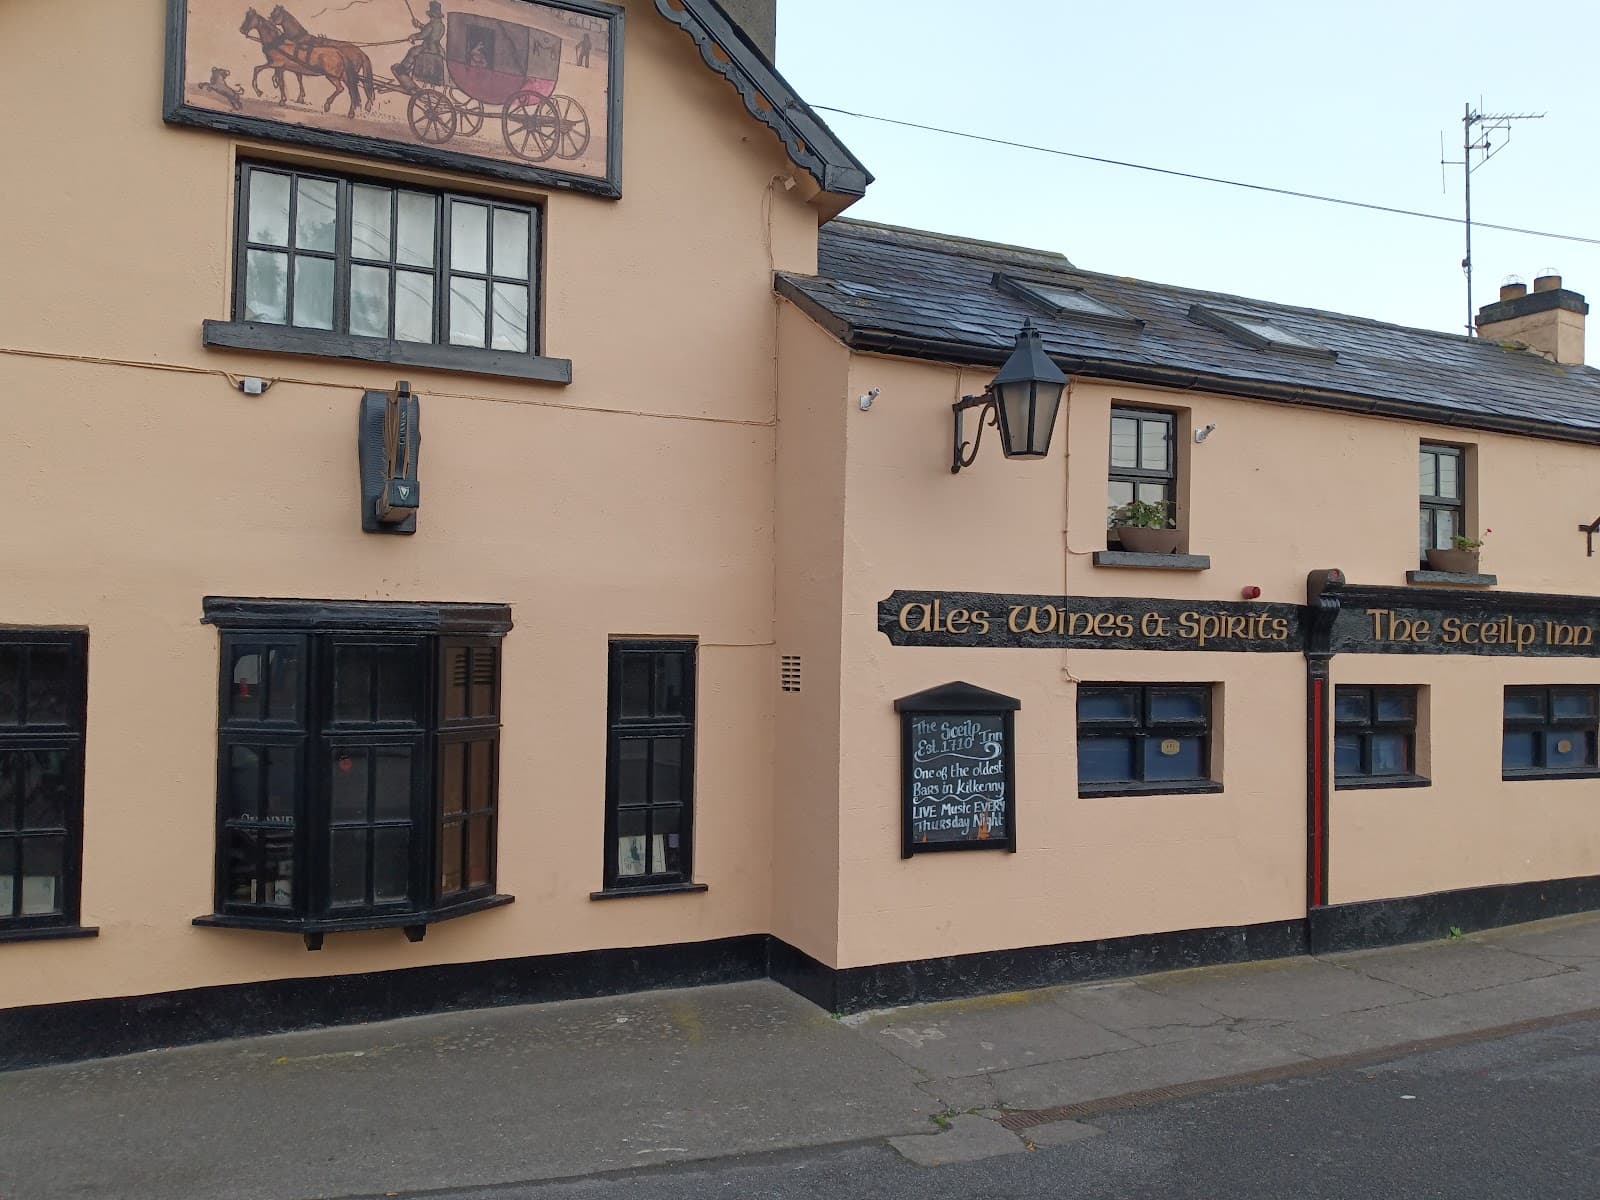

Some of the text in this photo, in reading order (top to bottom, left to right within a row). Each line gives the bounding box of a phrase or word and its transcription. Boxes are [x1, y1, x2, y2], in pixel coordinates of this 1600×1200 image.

[899, 599, 1289, 647] Ales Wines & Spirits
[1366, 608, 1594, 652] The Sceilp Inn
[913, 720, 937, 735] The
[979, 729, 1002, 744] Inn
[914, 760, 1003, 780] One of the oldest
[942, 781, 952, 793] in
[912, 800, 1005, 818] LIVE Music EVERY
[973, 812, 1004, 831] Night
